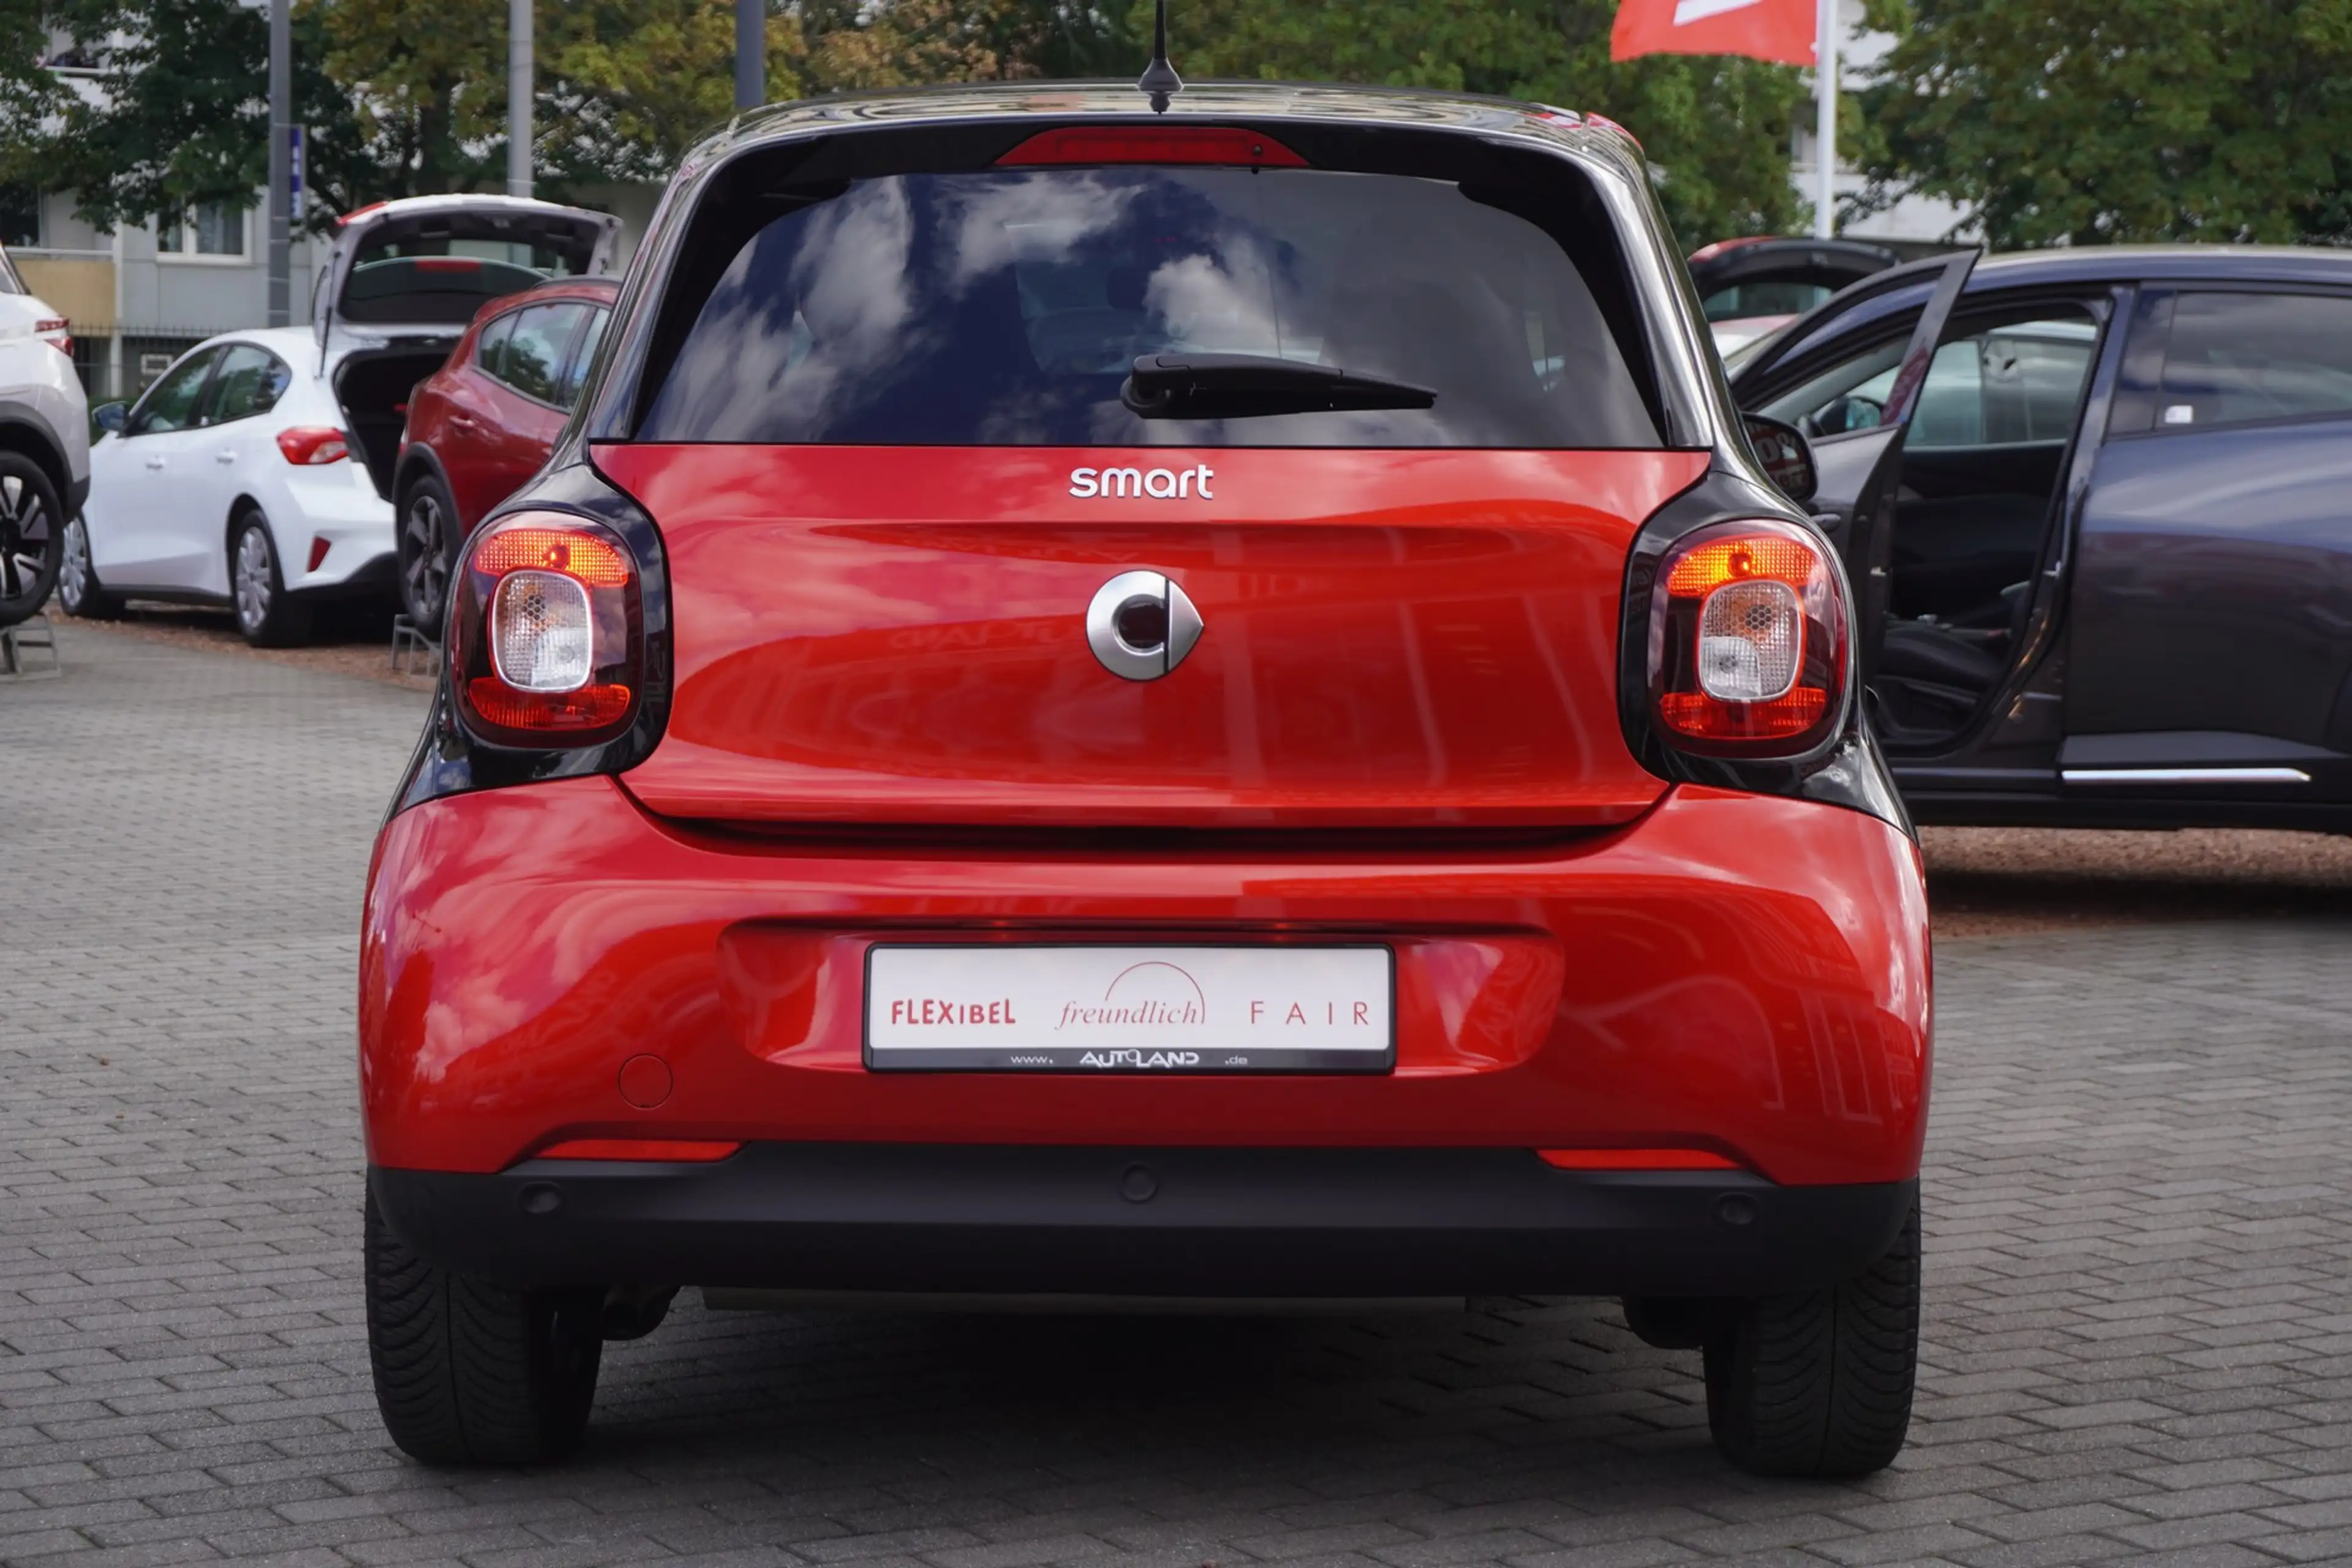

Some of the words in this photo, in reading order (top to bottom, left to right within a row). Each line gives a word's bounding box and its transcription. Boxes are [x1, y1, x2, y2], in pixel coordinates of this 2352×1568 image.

[1069, 464, 1214, 499] smart
[892, 998, 1016, 1025] FLEXIBEL
[1054, 1000, 1197, 1030] freundlich
[1010, 1055, 1054, 1065] www.
[1079, 1049, 1200, 1068] AUTOLAND
[1224, 1055, 1248, 1065] .de
